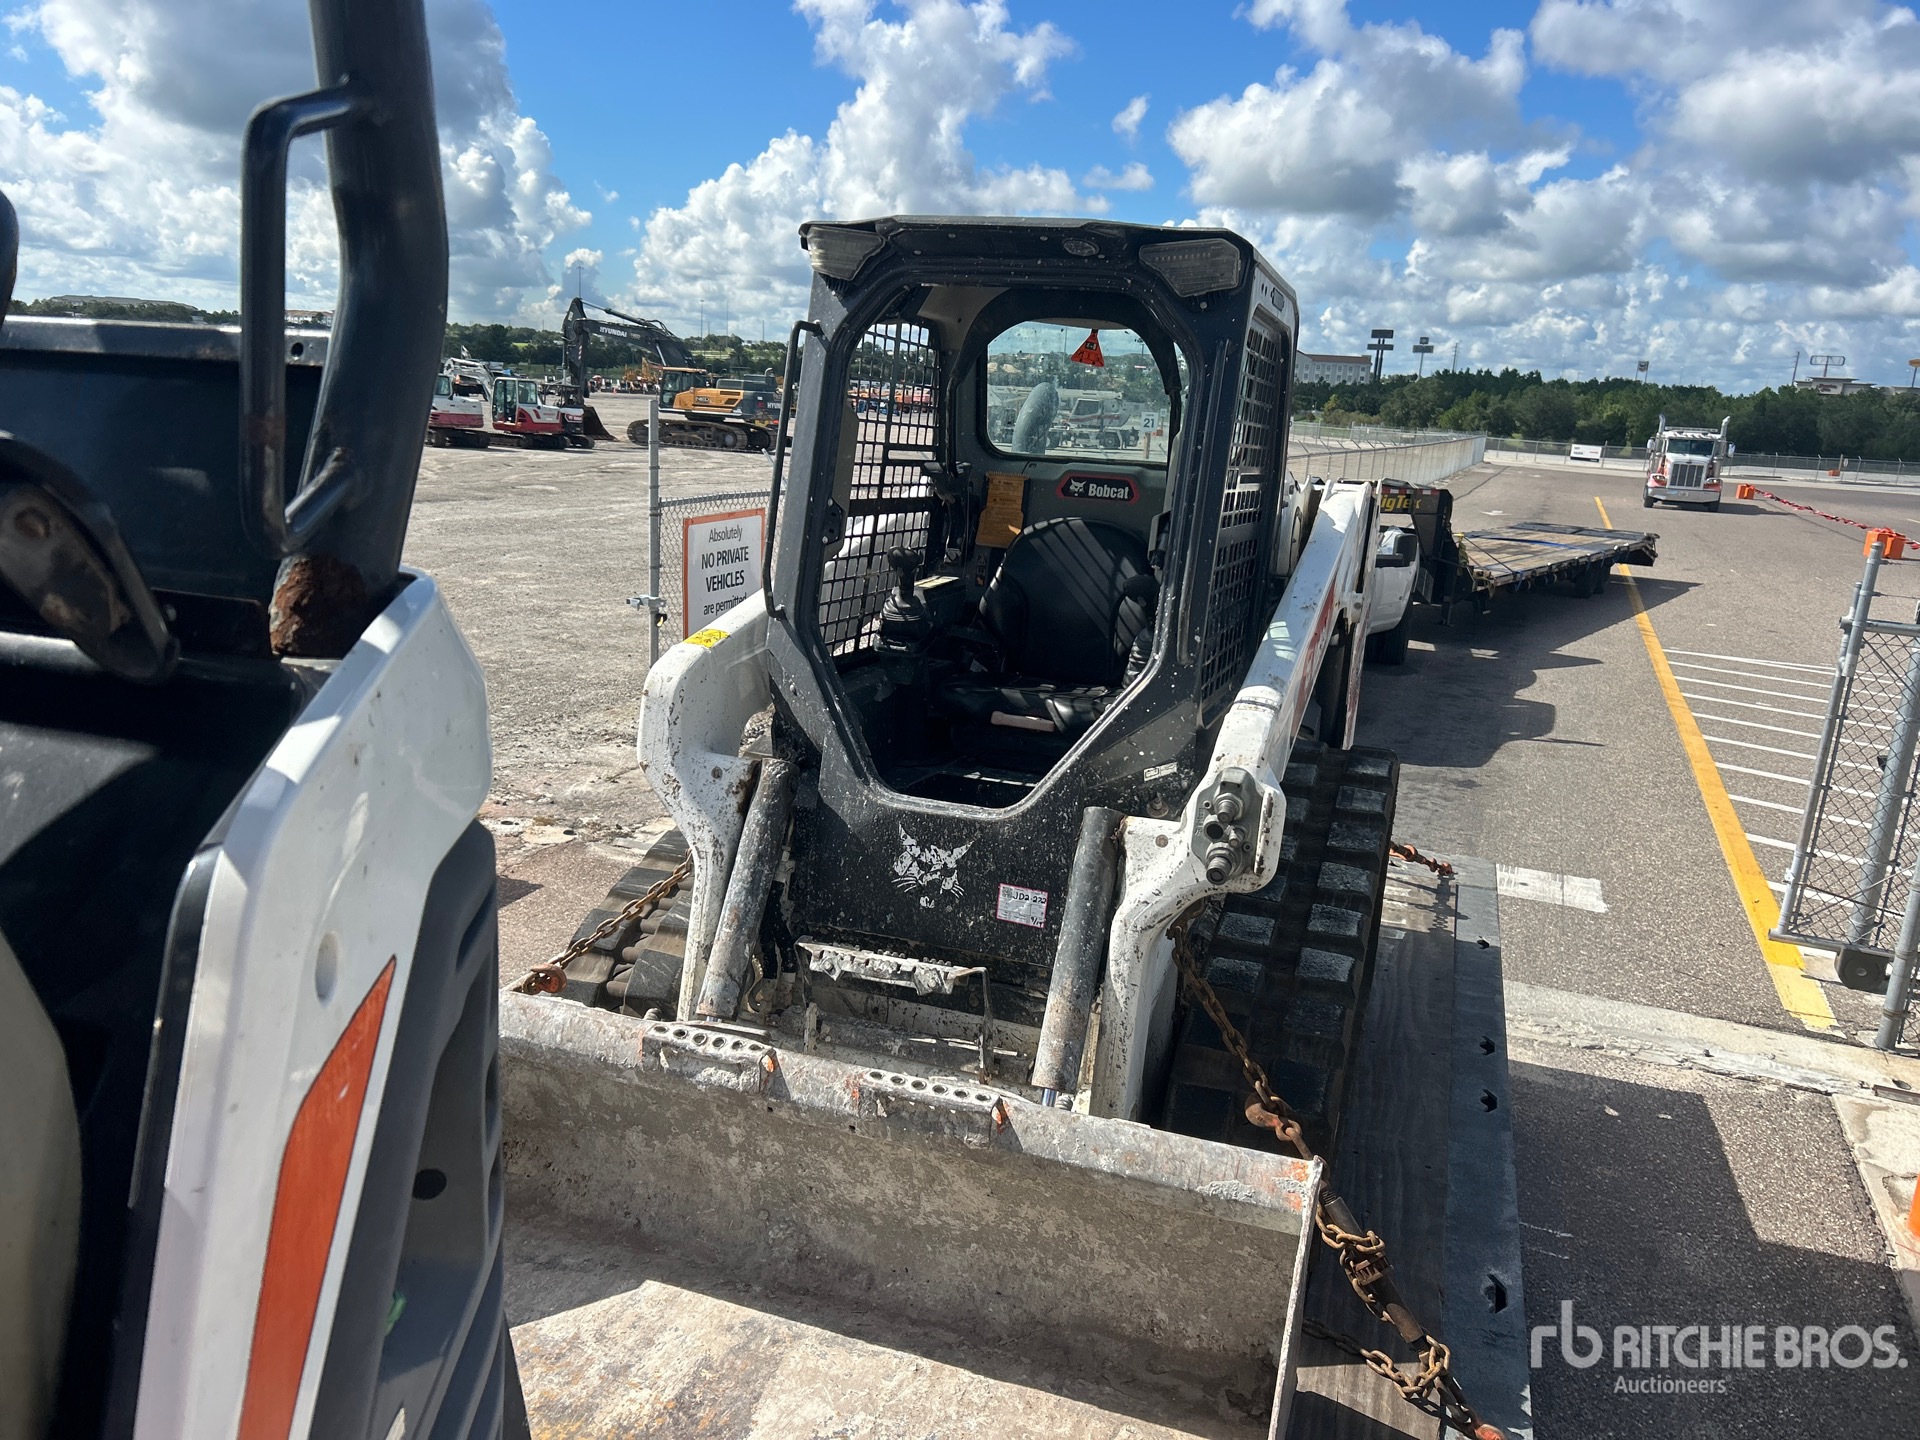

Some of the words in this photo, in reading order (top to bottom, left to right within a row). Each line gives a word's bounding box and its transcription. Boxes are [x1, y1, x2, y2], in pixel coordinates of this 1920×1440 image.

[599, 326, 628, 338] HYUNDAI
[1143, 417, 1155, 428] 21
[1088, 483, 1130, 500] Bobcat
[709, 525, 742, 543] Absolutely
[701, 552, 715, 570] NO
[716, 546, 749, 567] PRIVATE
[706, 570, 744, 592] VEHICLES
[703, 603, 714, 616] are
